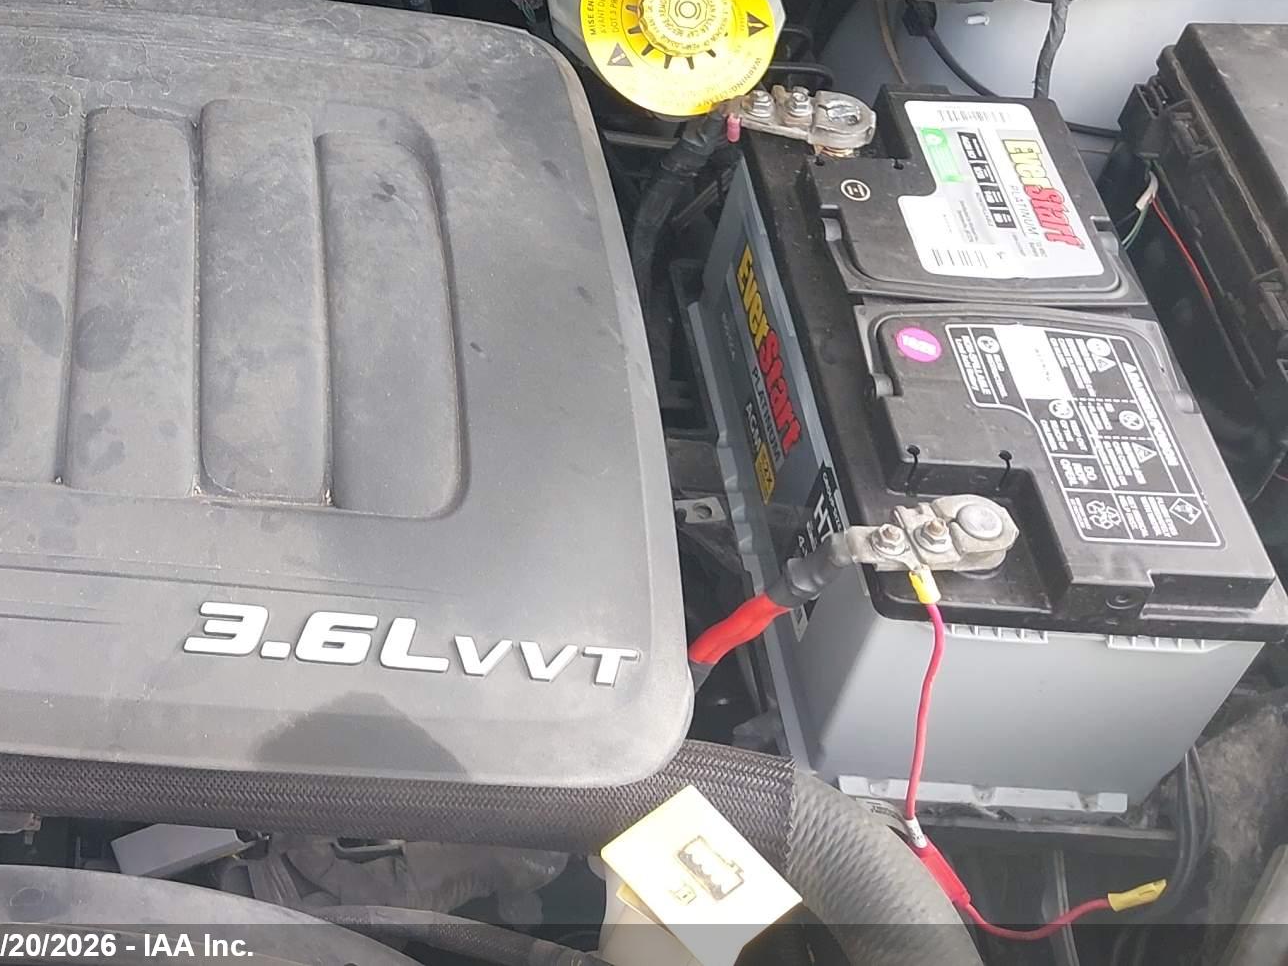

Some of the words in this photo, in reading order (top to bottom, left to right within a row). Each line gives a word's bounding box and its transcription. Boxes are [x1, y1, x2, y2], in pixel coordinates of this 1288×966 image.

[589, 1, 595, 17] EN
[589, 17, 597, 35] MISE
[1002, 140, 1084, 247] EverStart
[1010, 185, 1040, 236] PLATINUM
[736, 244, 801, 459] EverStart
[745, 401, 761, 452] AGM
[752, 367, 781, 462] PLATINUM
